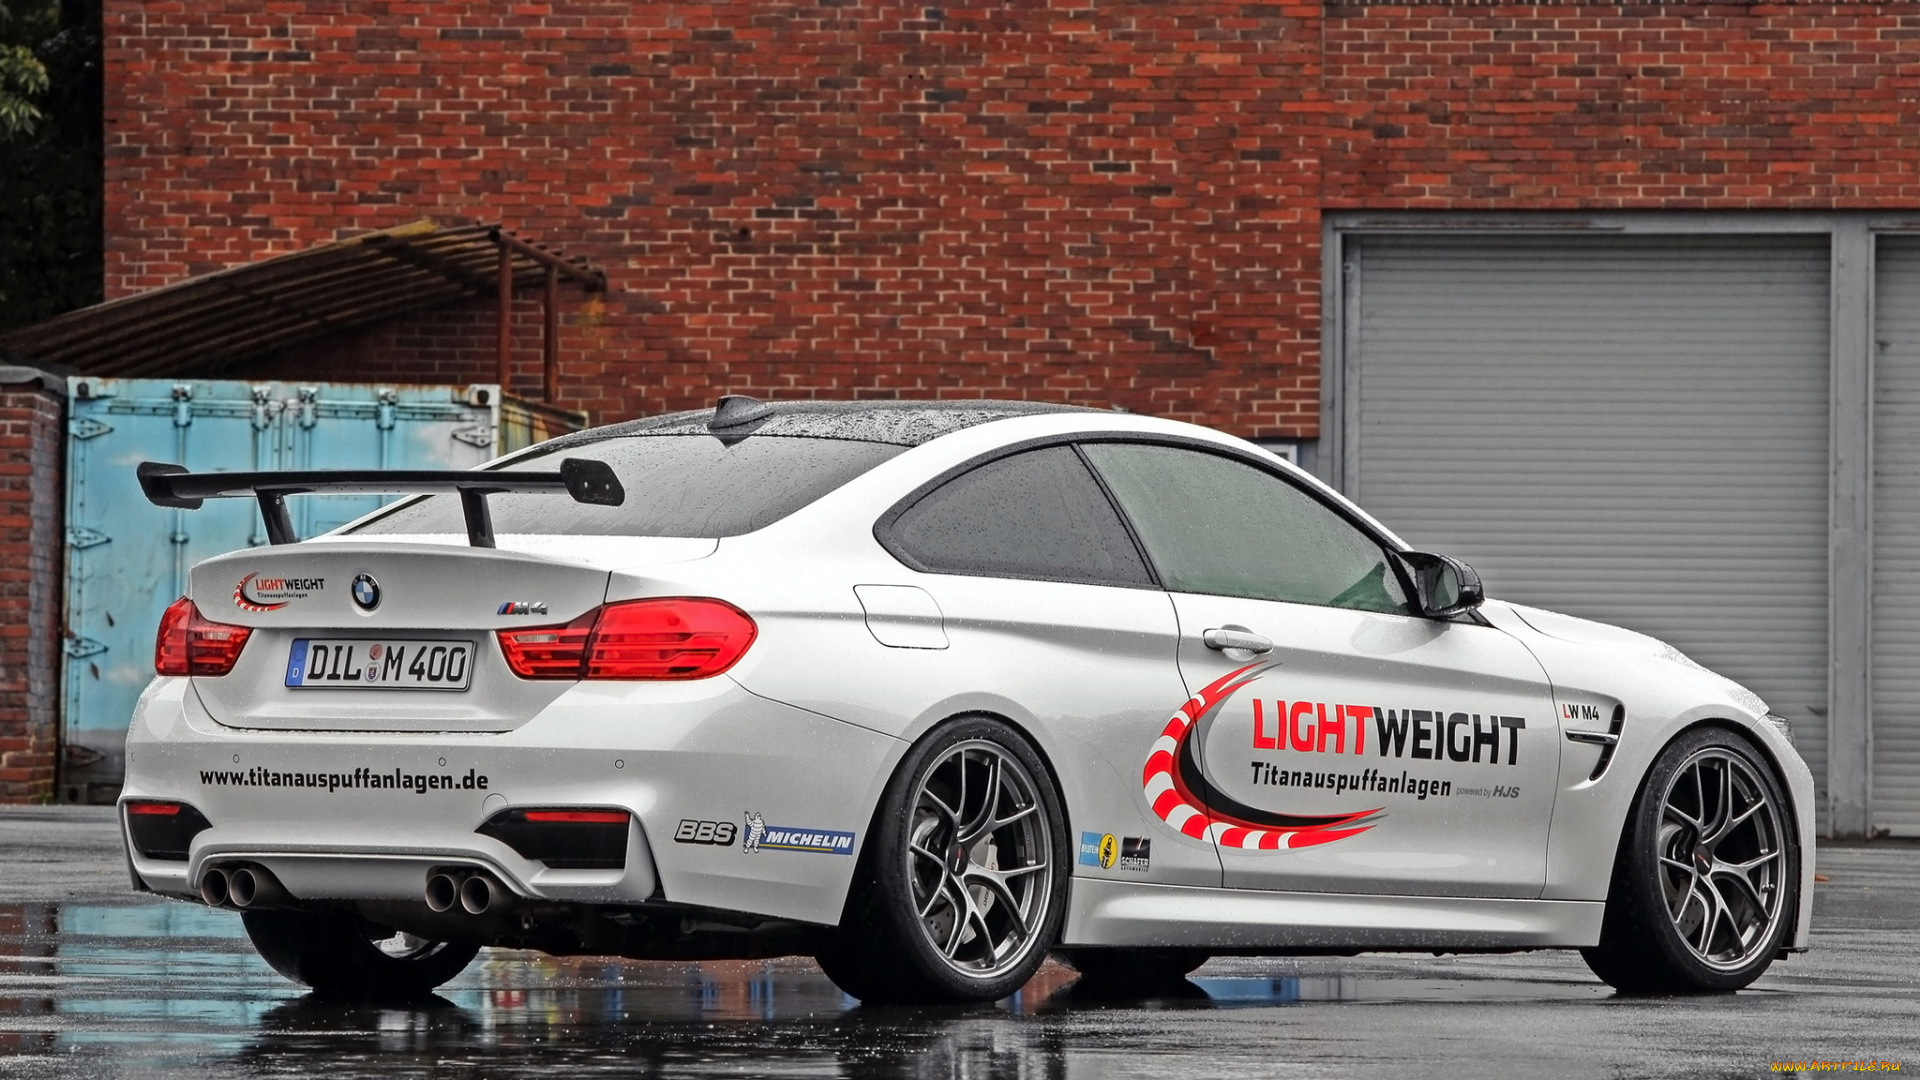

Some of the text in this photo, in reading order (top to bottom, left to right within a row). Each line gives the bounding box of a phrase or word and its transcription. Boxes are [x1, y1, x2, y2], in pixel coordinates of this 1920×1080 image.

[255, 578, 325, 590] LIGHTWEIGHT
[292, 667, 300, 678] D
[307, 645, 467, 682] DIL M 400
[1562, 703, 1599, 720] LW M4
[1252, 698, 1526, 766] LIGHTWEIGHT
[200, 767, 489, 794] www.titanauspuffanlagen.de
[1251, 761, 1520, 800] Titanauspuffanlagen powered by HJS
[674, 819, 738, 846] BBS
[766, 831, 852, 848] MICHELIN
